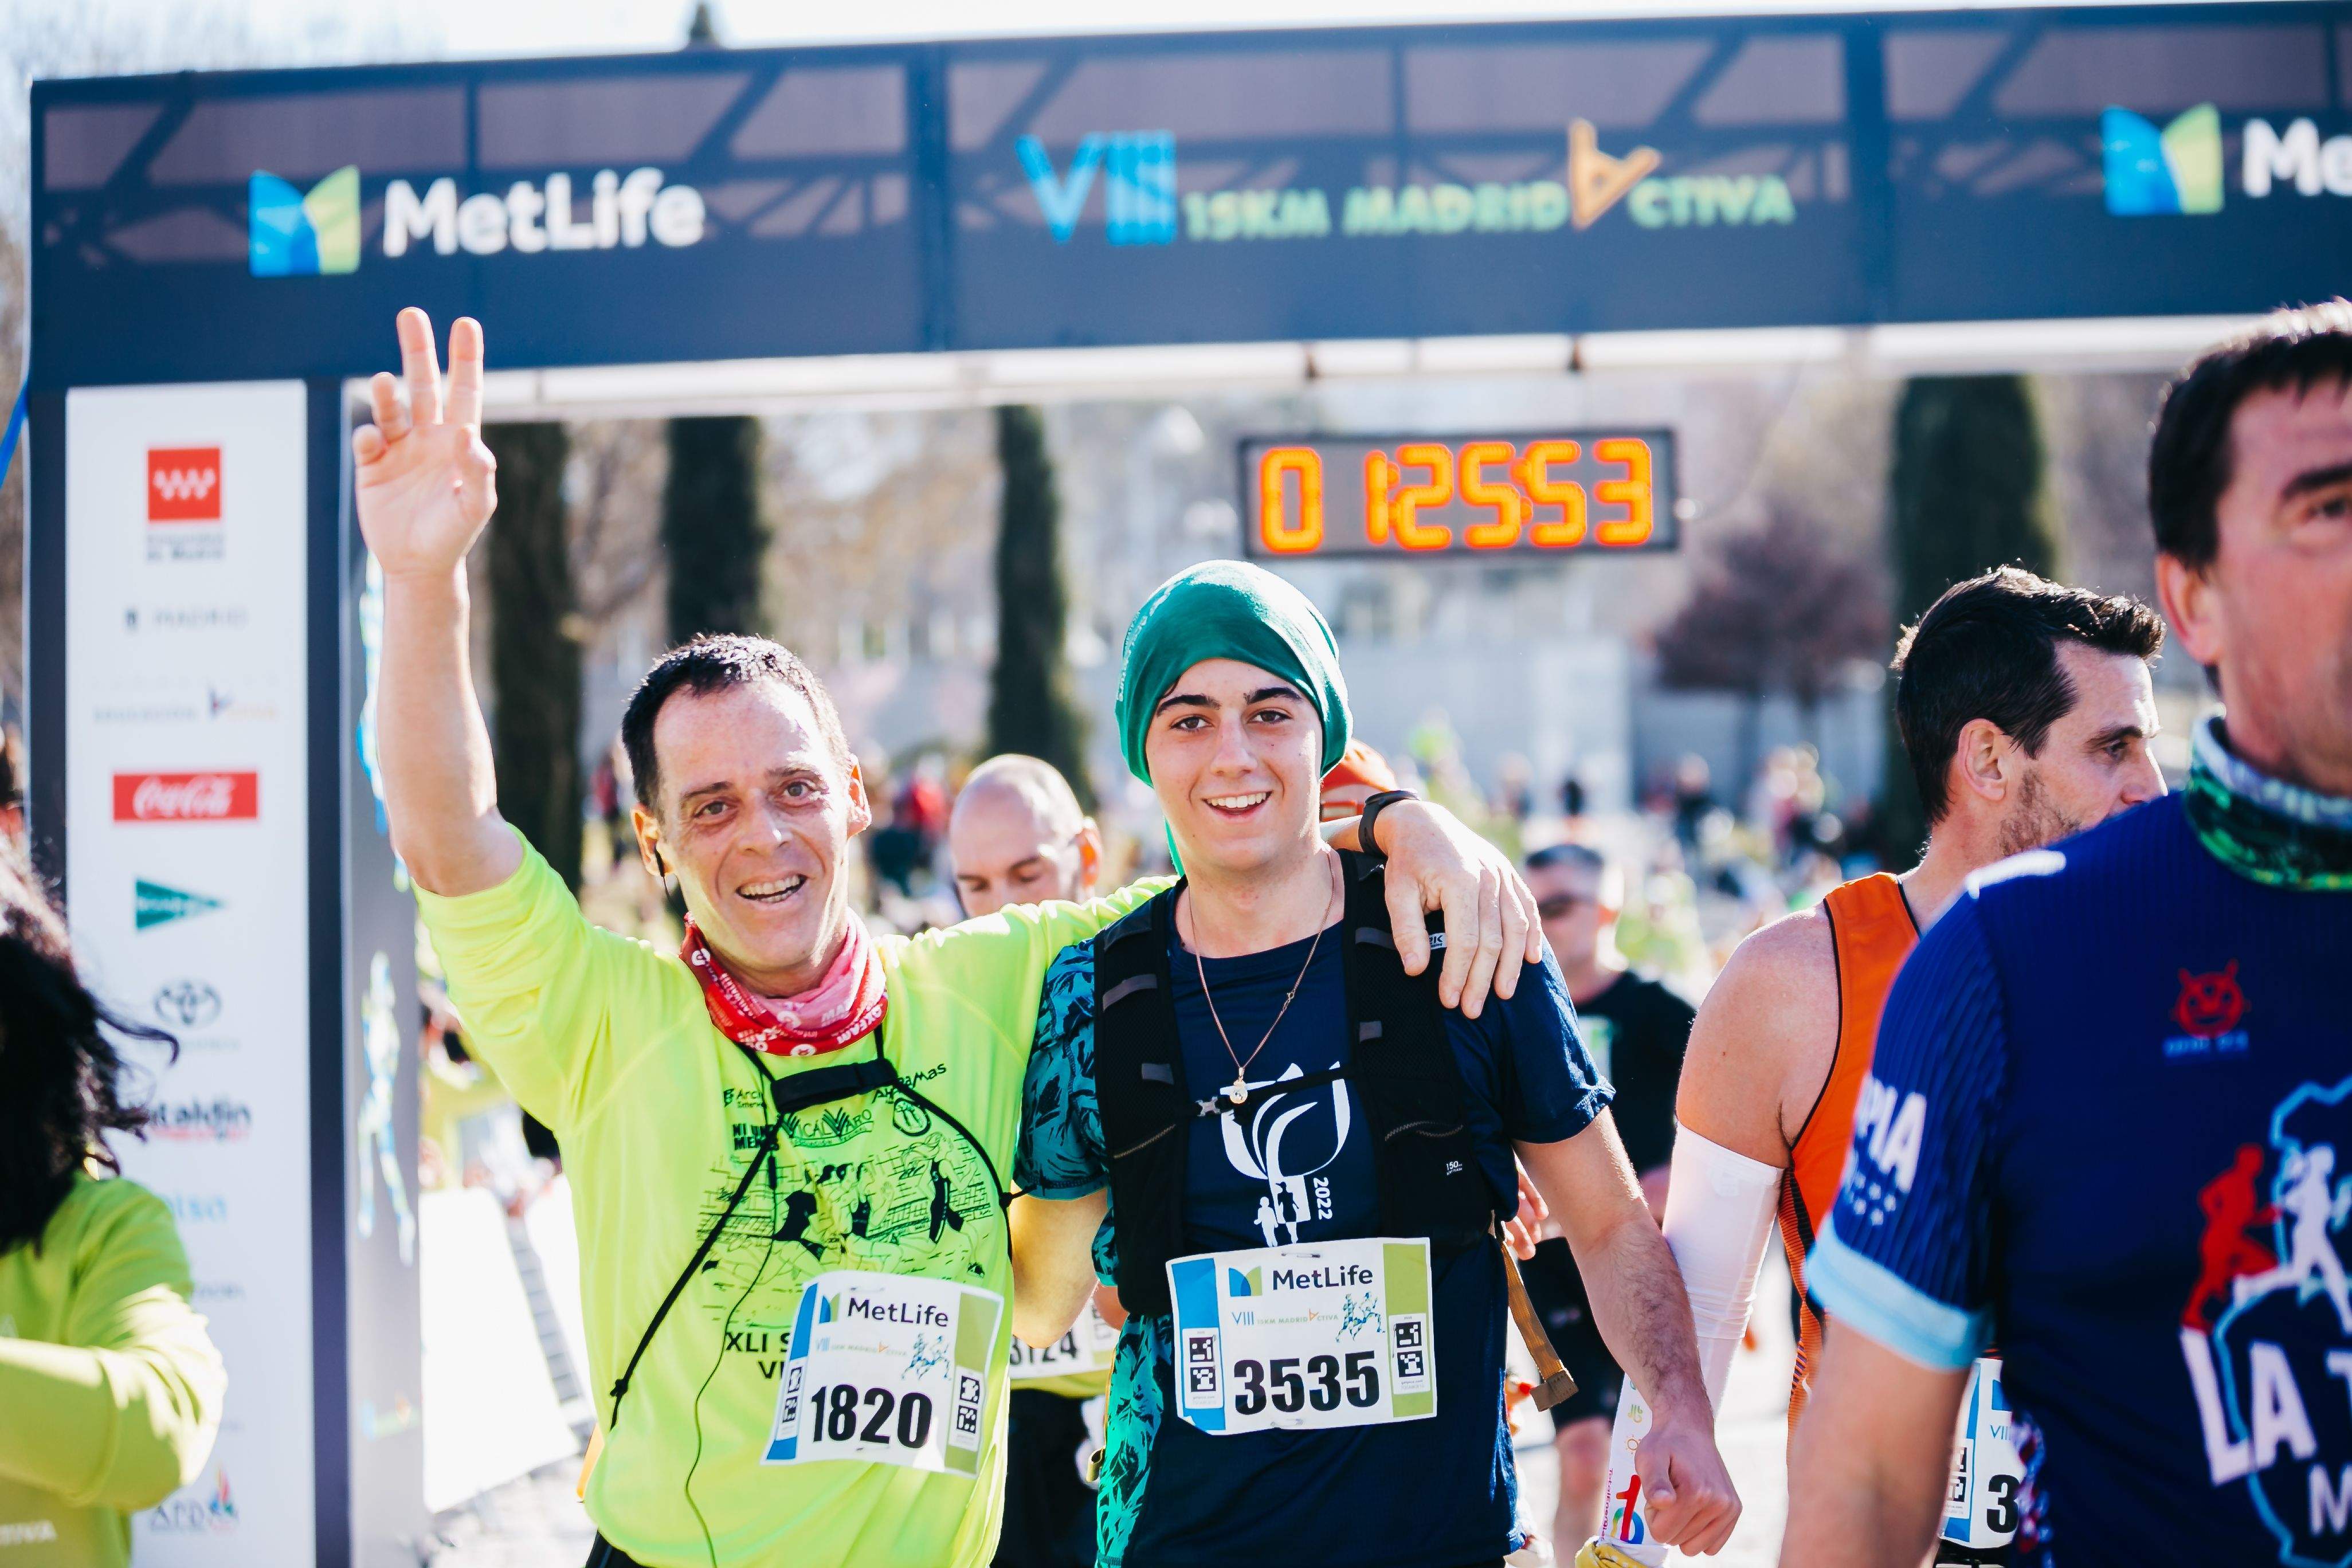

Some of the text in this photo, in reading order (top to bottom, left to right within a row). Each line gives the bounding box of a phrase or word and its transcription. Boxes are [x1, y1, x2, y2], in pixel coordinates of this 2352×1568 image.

[383, 167, 706, 258] MetLife
[1014, 128, 1177, 246] VIII
[1184, 187, 1331, 242] 15KM
[1313, 1177, 1333, 1220] 2022
[1272, 1264, 1374, 1291] MetLife
[725, 1332, 767, 1353] XLI
[847, 1297, 949, 1327] MetLife
[1232, 1311, 1255, 1326] VIII
[811, 1383, 932, 1449] 1820
[1233, 1350, 1380, 1416] 3535
[2179, 1326, 2317, 1487] LA
[1986, 1474, 2022, 1540] 3
